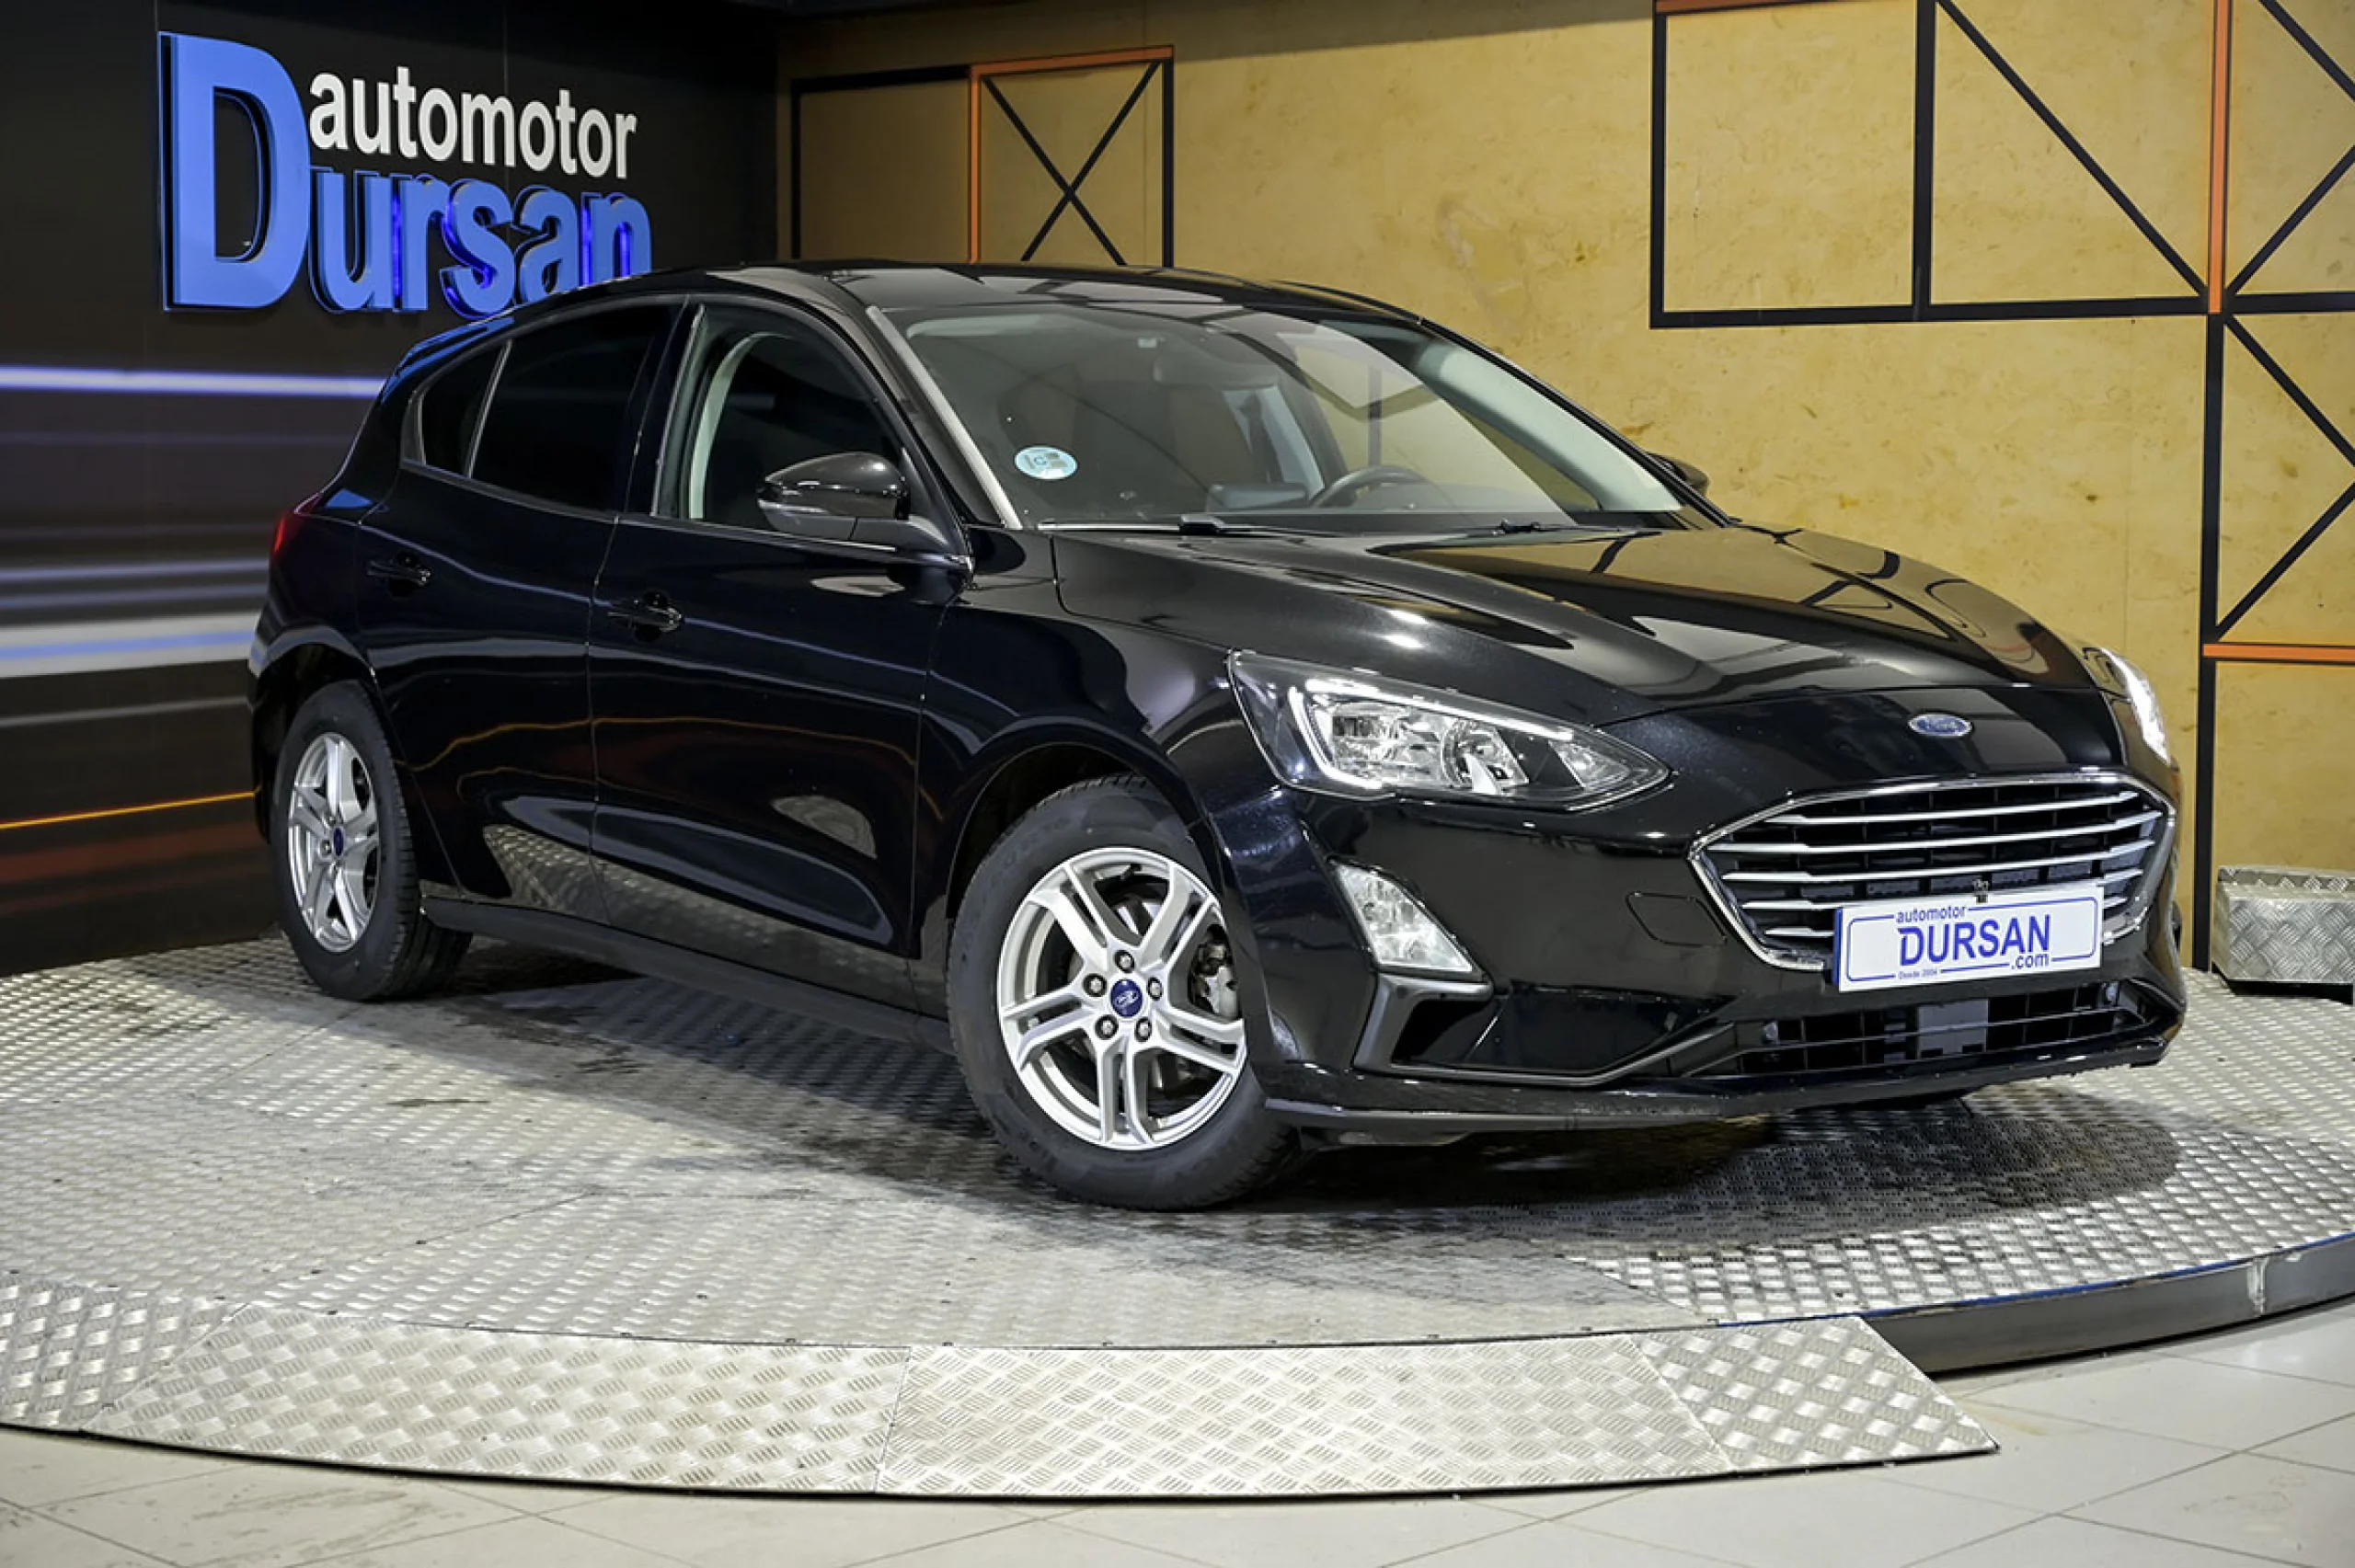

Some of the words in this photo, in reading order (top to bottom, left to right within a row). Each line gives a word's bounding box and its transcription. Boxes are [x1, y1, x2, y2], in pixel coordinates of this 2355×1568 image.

[309, 66, 638, 179] automotor
[158, 31, 652, 320] Dursan
[1896, 907, 1966, 923] automotor
[1898, 914, 2051, 966] DURSAN
[2012, 952, 2050, 969] .com
